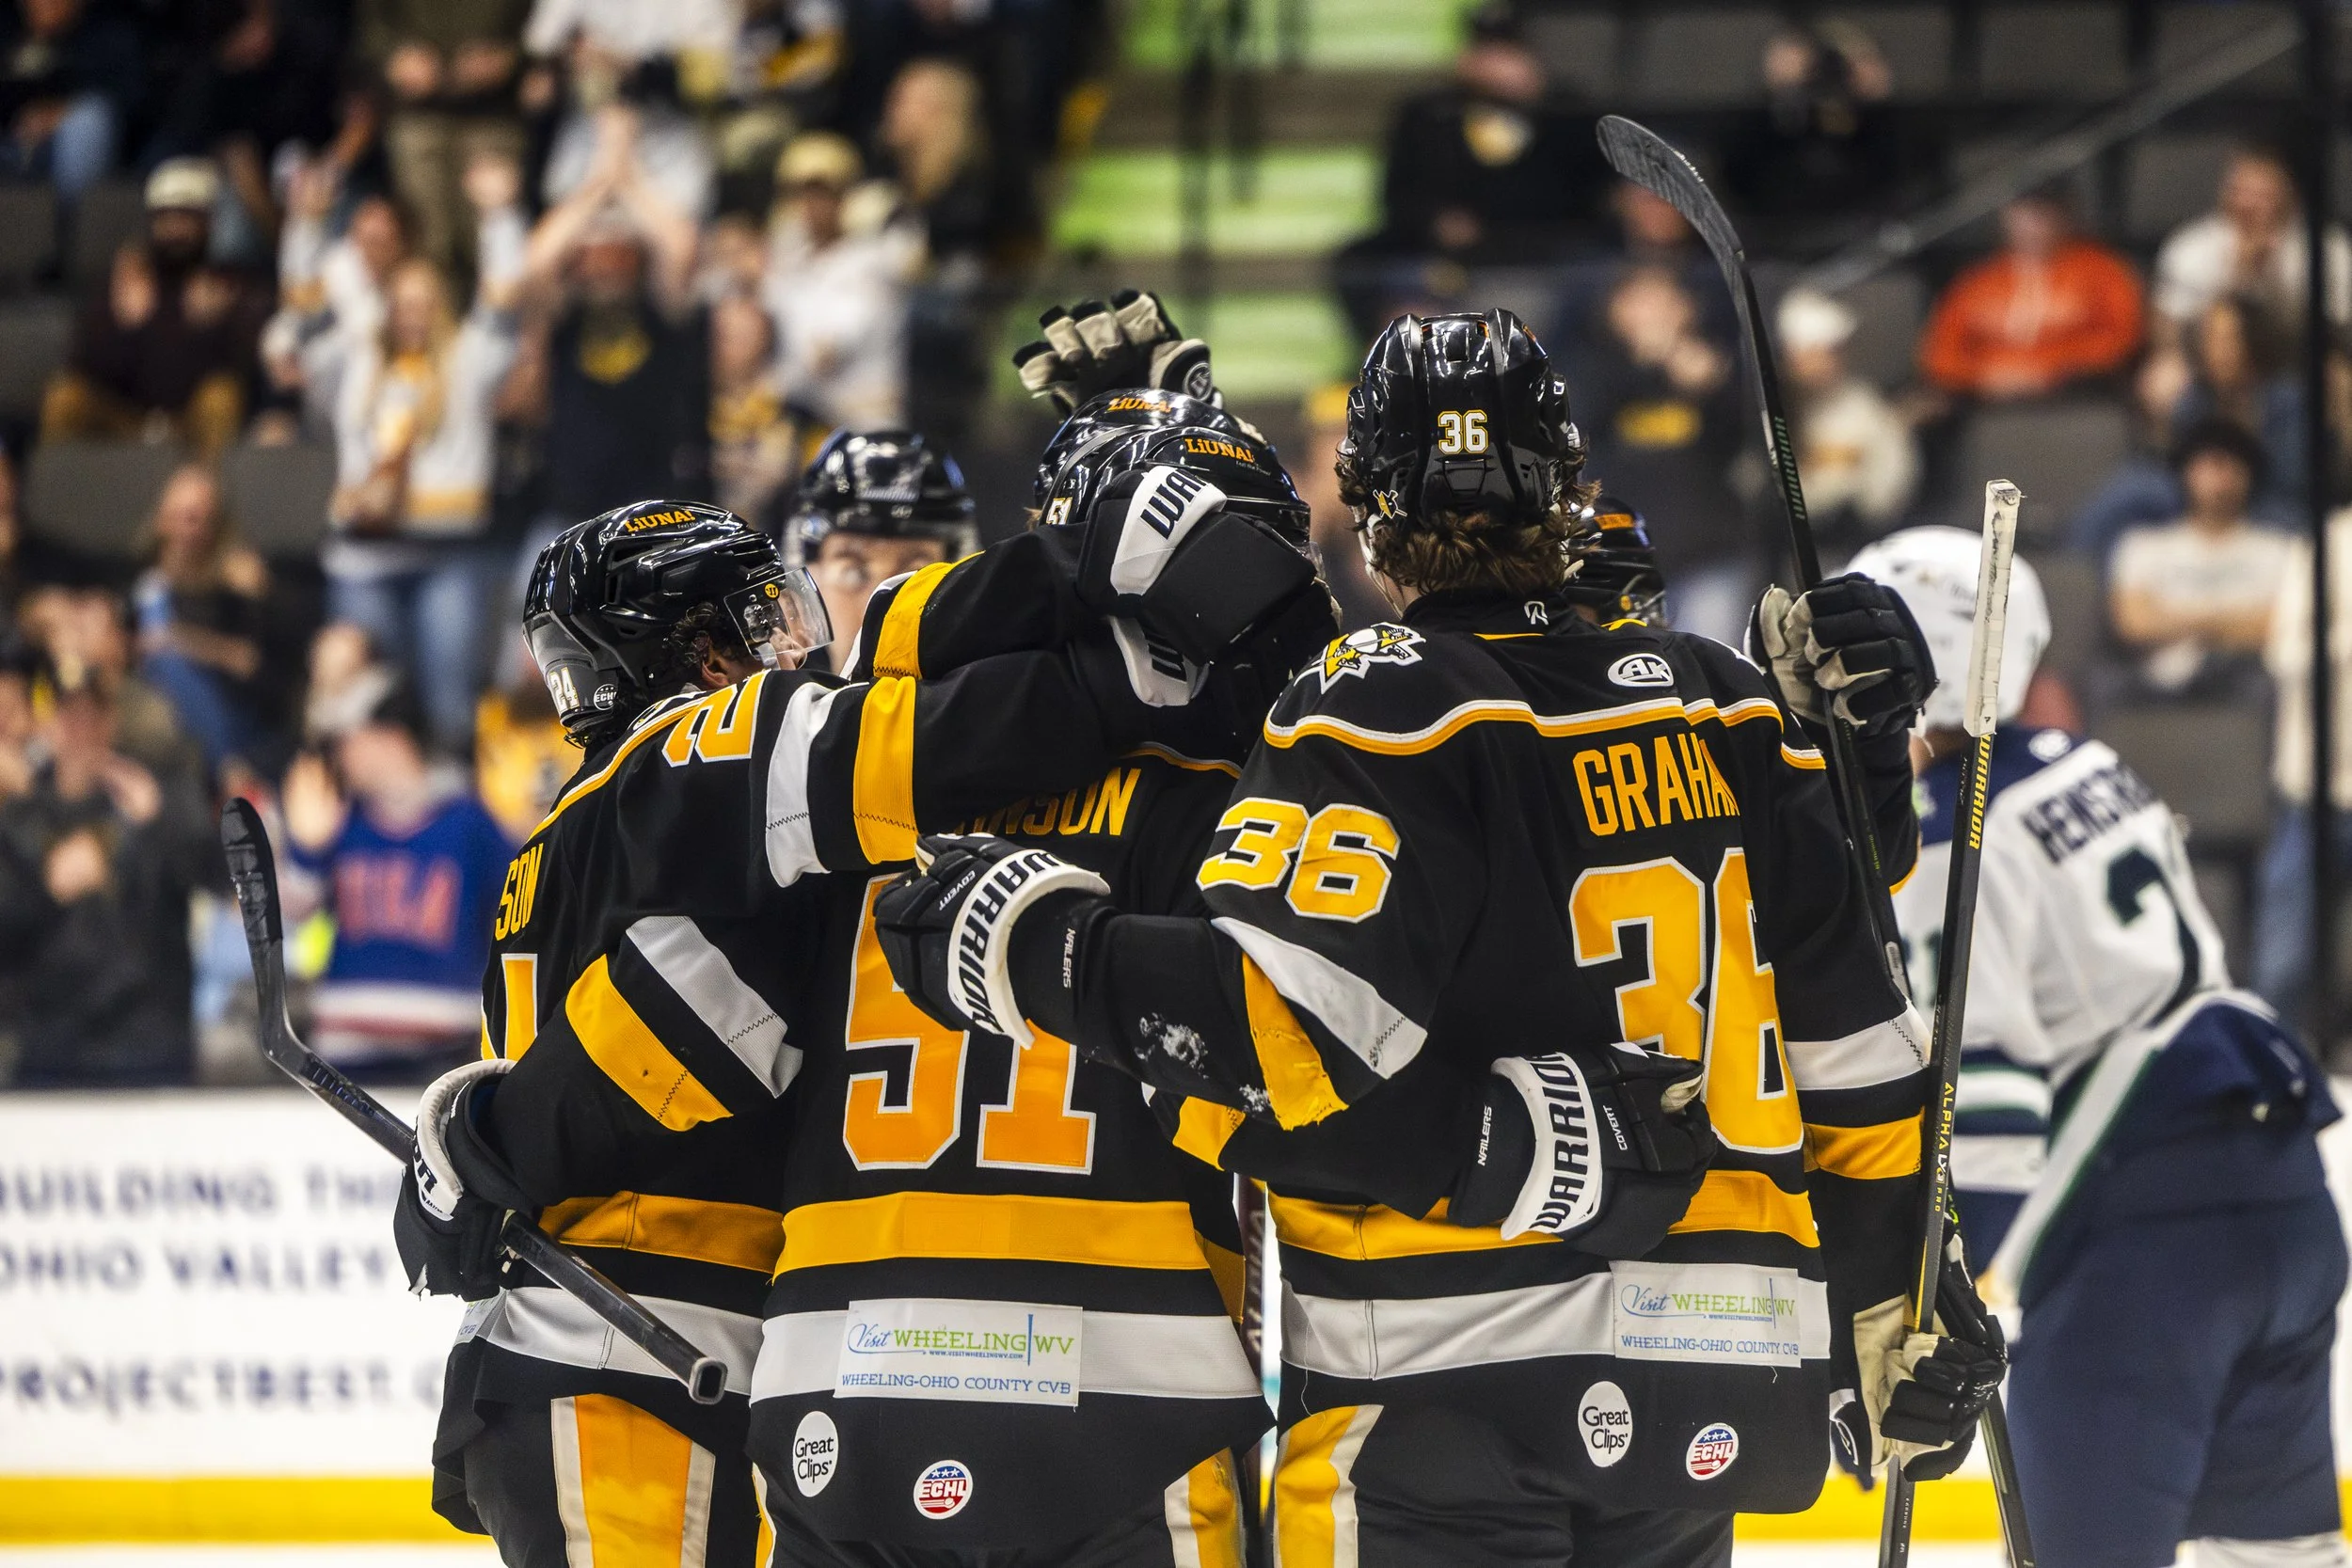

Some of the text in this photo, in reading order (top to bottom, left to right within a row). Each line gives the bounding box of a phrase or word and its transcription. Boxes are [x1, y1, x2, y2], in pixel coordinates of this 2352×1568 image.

[1438, 409, 1489, 455] 36
[624, 509, 696, 533] LiUNA!
[1046, 497, 1073, 526] 51
[548, 666, 580, 713] 24
[1196, 797, 1401, 923] 36
[938, 869, 977, 911] COVERT
[1062, 927, 1076, 989] NAILERS
[1568, 847, 1804, 1154] 36
[843, 871, 1096, 1176] 51
[1602, 1104, 1629, 1151] COVERT
[1938, 1082, 1955, 1150] ALPHA
[1477, 1105, 1492, 1166] NAILERS
[1934, 1187, 1943, 1212] PRO
[160, 1245, 388, 1291] VALLEY
[1621, 1284, 1796, 1317] Visit WHEELING WV
[848, 1323, 1075, 1354] Visit WHEELING WV
[1621, 1335, 1799, 1355] WHEELING-OHIO COUNTY CVB
[841, 1372, 1072, 1395] WHEELING-OHIO COUNTY CVB
[1582, 1405, 1629, 1427] Great
[794, 1436, 834, 1459] Great
[1693, 1442, 1734, 1462] ECHL
[920, 1479, 967, 1499] ECHL
